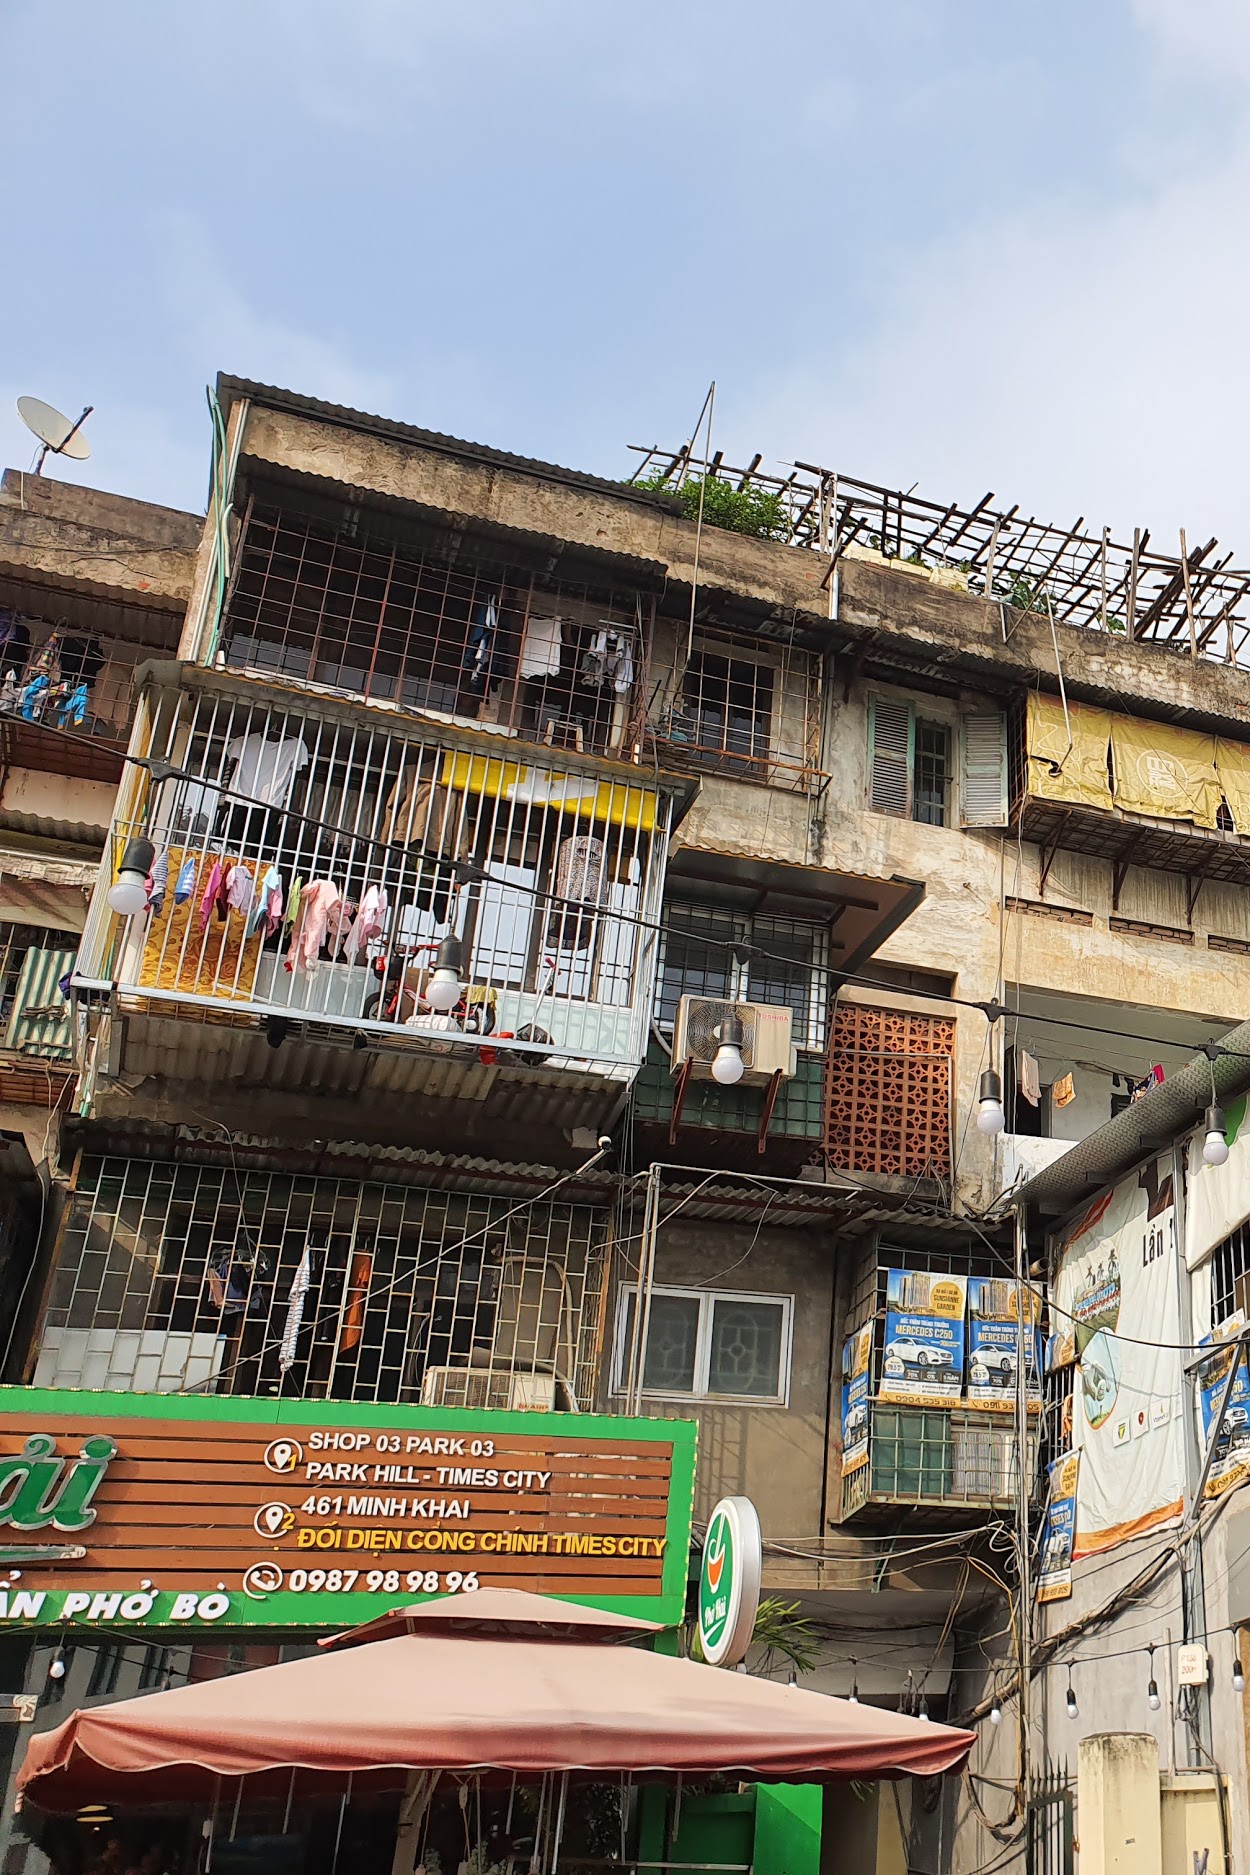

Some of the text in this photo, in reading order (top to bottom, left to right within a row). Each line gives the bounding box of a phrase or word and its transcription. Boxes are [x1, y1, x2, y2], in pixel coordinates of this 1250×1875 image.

[758, 1012, 788, 1021] TOSHIBA
[1143, 1223, 1163, 1268] Lần
[896, 1325, 934, 1337] MERCEDES
[978, 1332, 1014, 1343] MERCEDES
[308, 1432, 494, 1457] SHOP 03 PARK 03
[305, 1462, 370, 1482] PARK
[374, 1464, 420, 1483] HILL
[437, 1467, 498, 1487] TIMES
[503, 1470, 551, 1489] CITY
[301, 1496, 470, 1519] 461 MINH KHAI
[297, 1520, 342, 1549] ĐỐI
[347, 1524, 403, 1558] DIỆN
[480, 1525, 548, 1552] CHÍNH
[553, 1535, 618, 1555] TIMES
[618, 1537, 668, 1556] CITY
[289, 1569, 480, 1593] 0987 98 98 96
[60, 1579, 230, 1620] PHỞ BÒ
